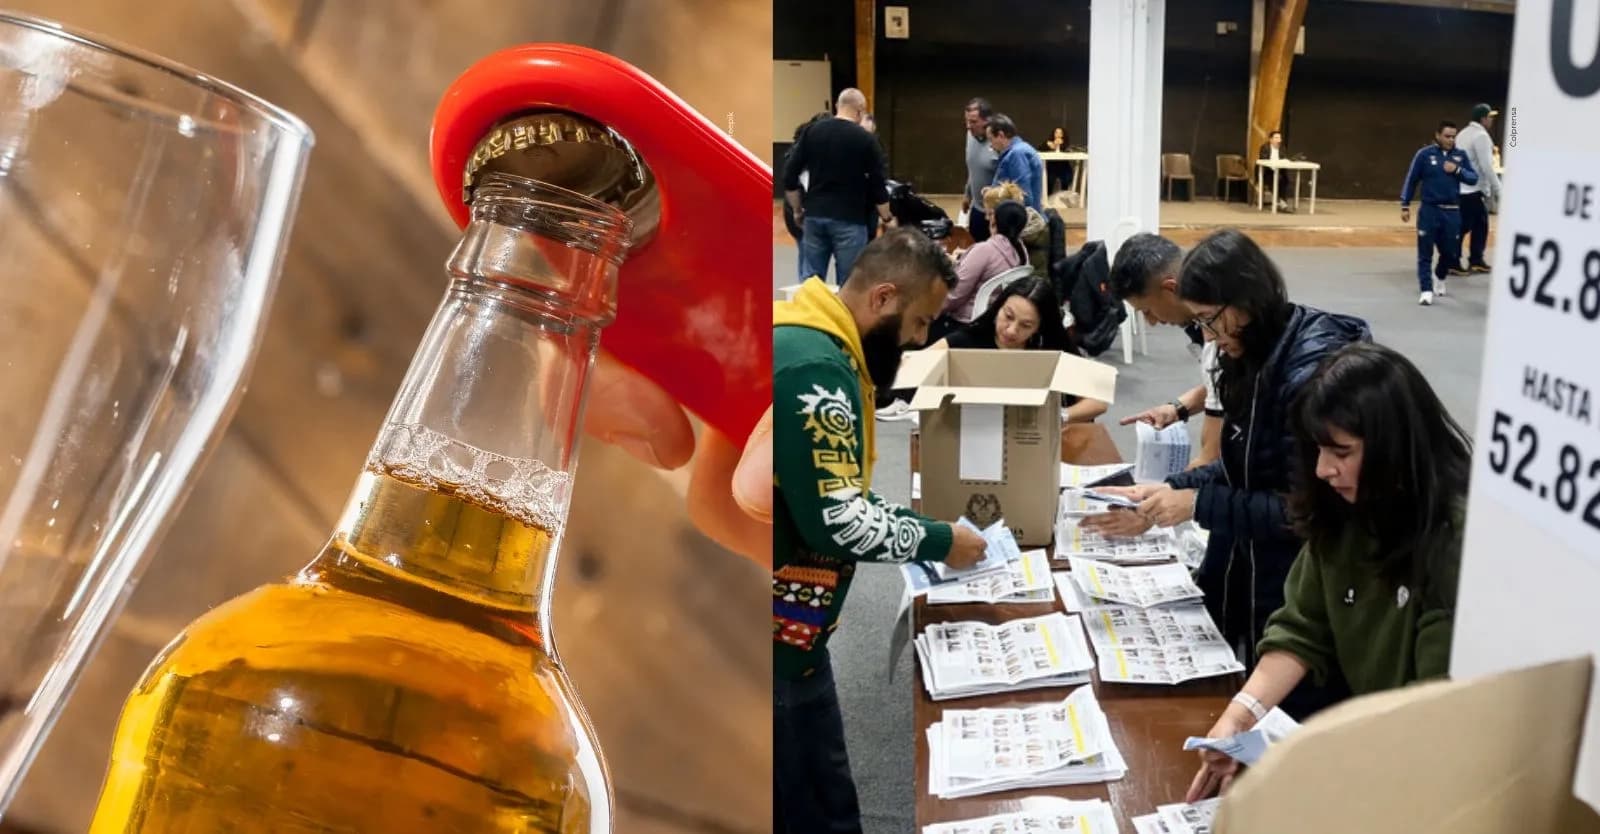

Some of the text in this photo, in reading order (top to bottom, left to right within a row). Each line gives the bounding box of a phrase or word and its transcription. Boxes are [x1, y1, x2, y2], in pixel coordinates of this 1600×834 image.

[1564, 182, 1594, 220] DE
[1509, 232, 1600, 322] 52.8
[1522, 364, 1592, 425] HASTA
